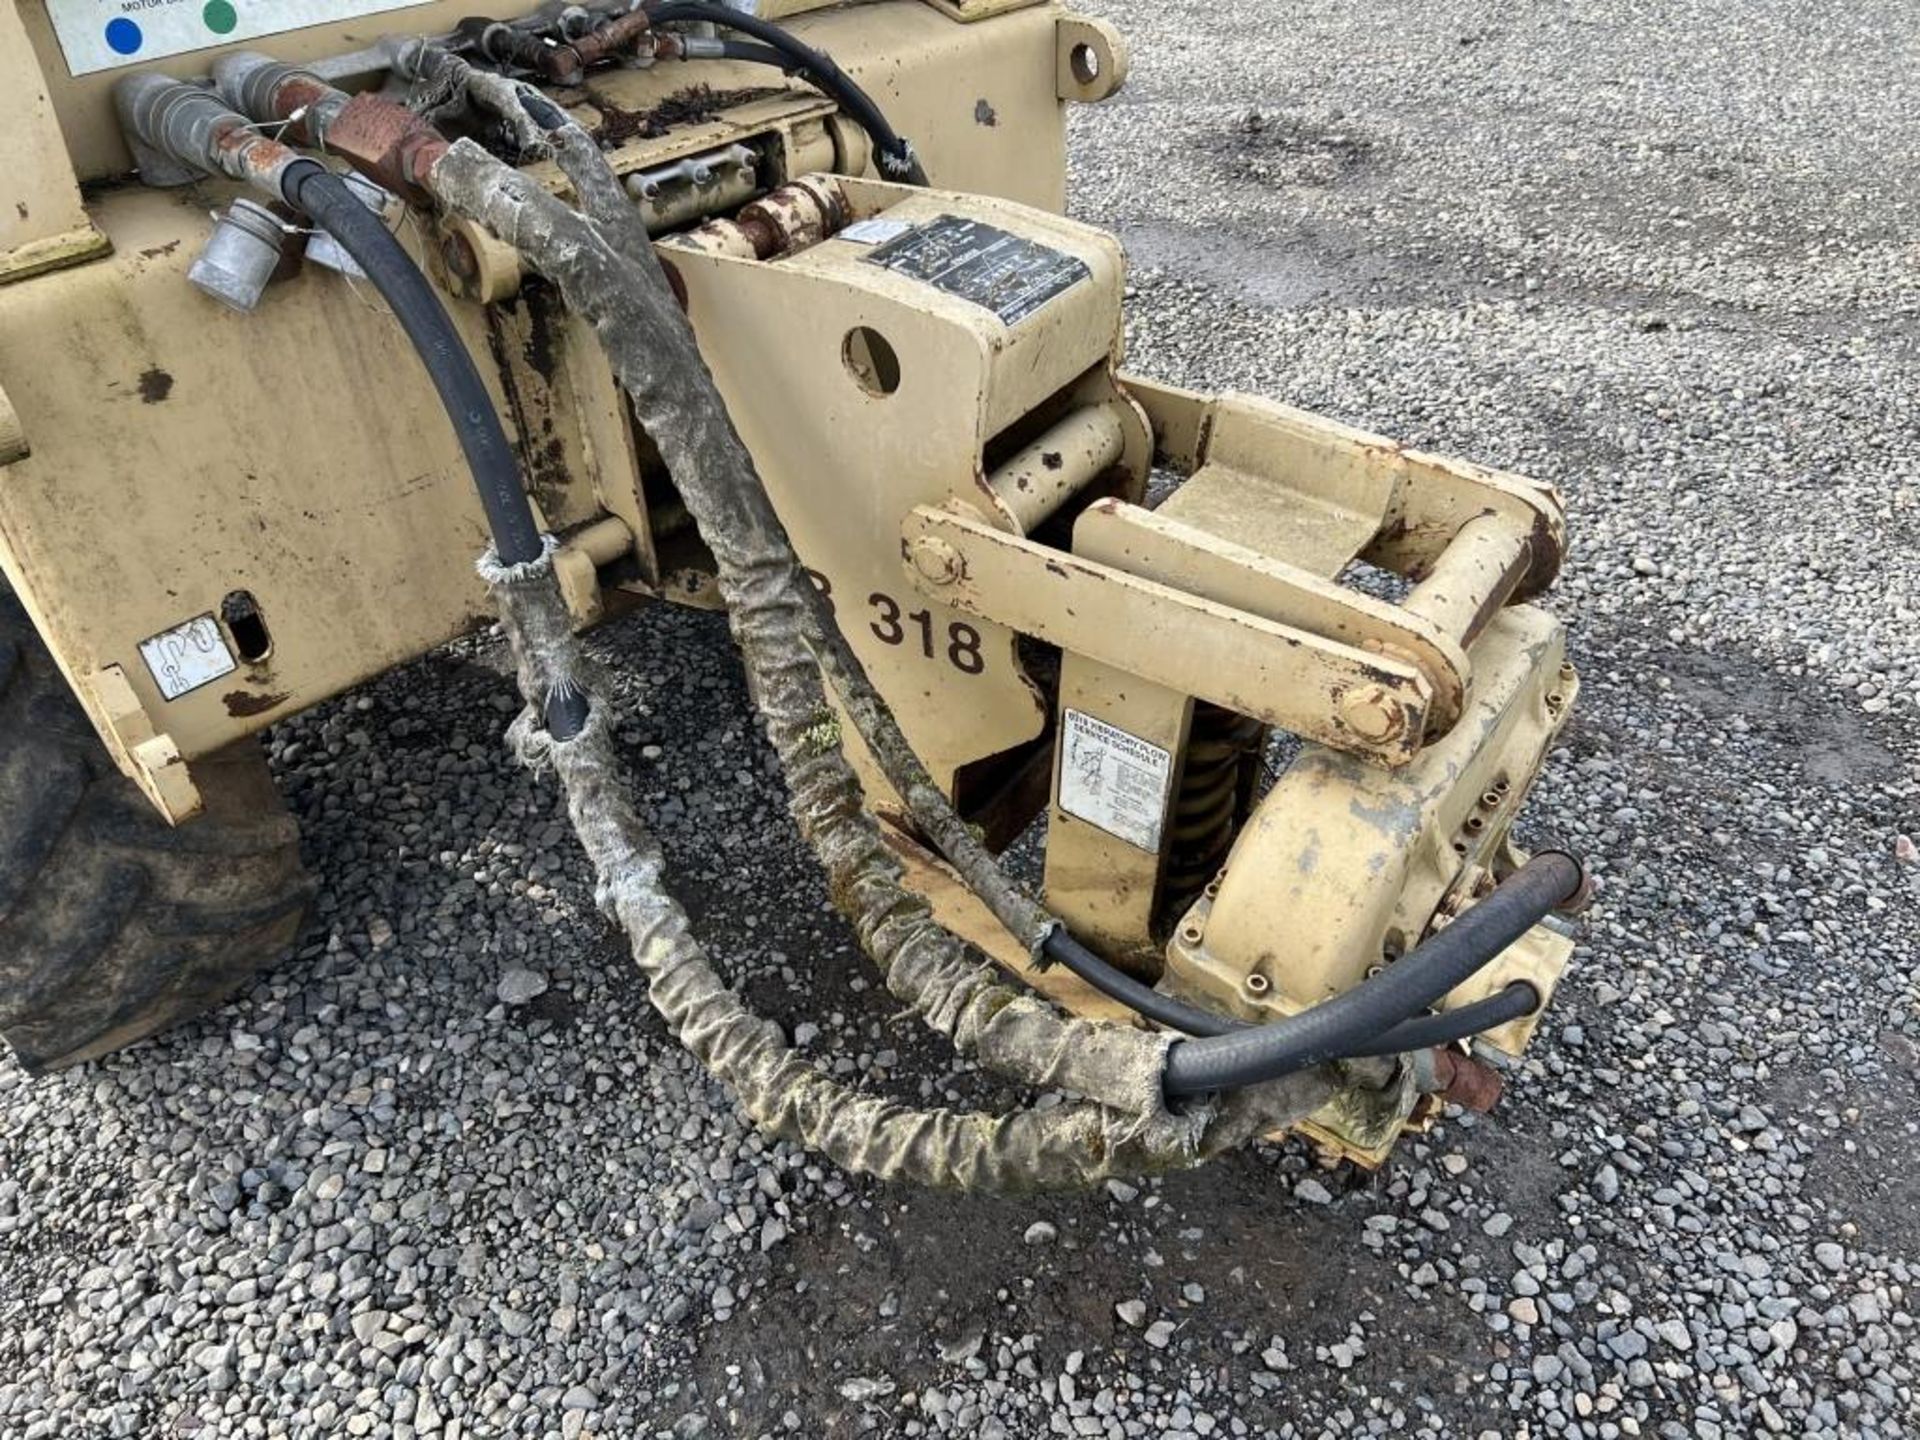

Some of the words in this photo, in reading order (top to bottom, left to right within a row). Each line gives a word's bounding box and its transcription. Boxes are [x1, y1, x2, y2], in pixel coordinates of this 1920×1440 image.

[868, 592, 985, 675] 318
[1073, 723, 1110, 745] SERVICE
[1111, 740, 1159, 768] SCHEDULE
[1090, 722, 1139, 749] VIBRATORY
[1139, 744, 1168, 762] PLOW
